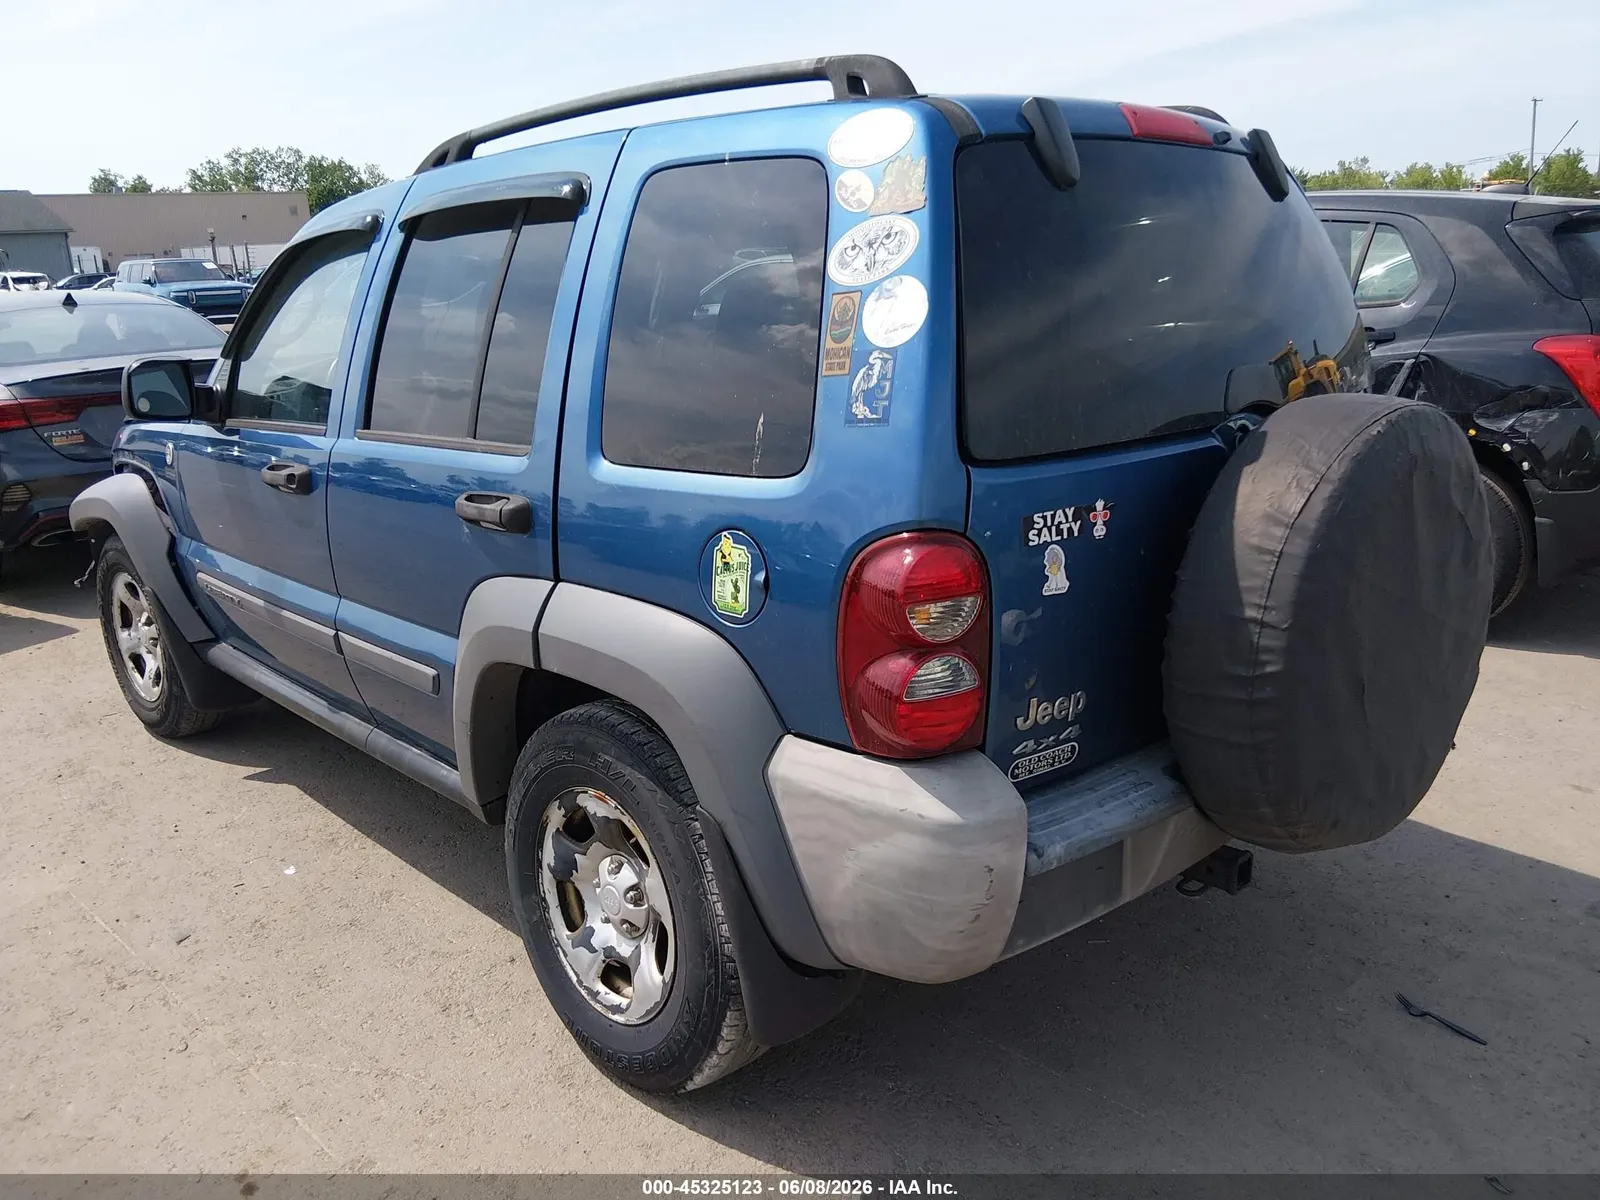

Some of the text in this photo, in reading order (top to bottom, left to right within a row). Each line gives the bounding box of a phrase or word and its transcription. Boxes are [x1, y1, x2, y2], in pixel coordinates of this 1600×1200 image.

[1033, 507, 1075, 529] STAY
[1028, 520, 1082, 546] SALTY
[1016, 691, 1086, 730] Jeep
[1012, 724, 1083, 755] 4x4
[1013, 757, 1054, 776] MOTORS
[1018, 746, 1072, 768] OLD COACH
